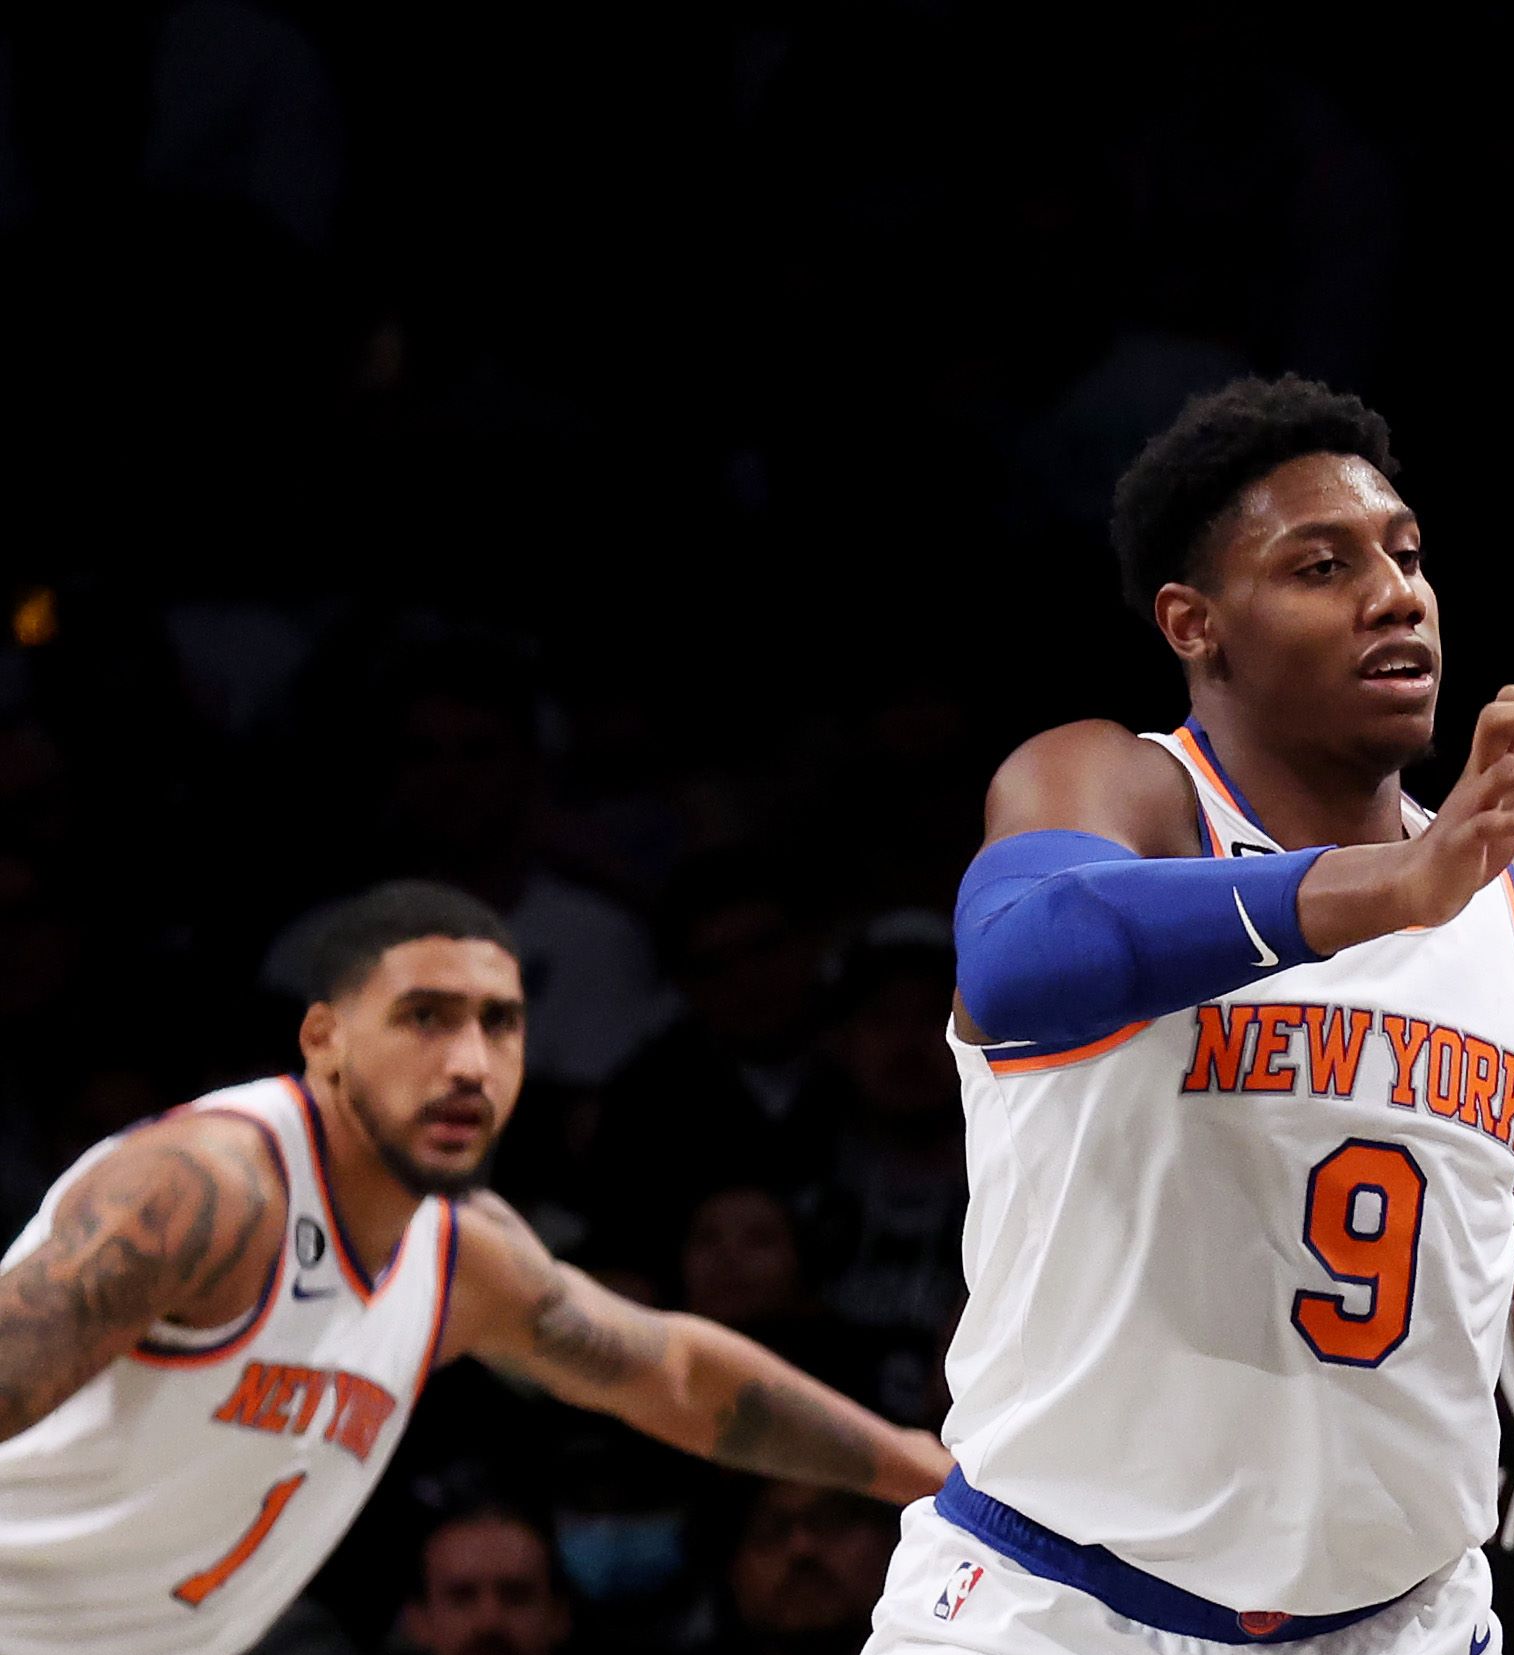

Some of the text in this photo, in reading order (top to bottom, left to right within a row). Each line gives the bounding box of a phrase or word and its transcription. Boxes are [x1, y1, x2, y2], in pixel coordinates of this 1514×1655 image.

[1180, 1001, 1374, 1099] NEW
[1291, 1137, 1427, 1368] 9
[172, 1472, 307, 1608] 1
